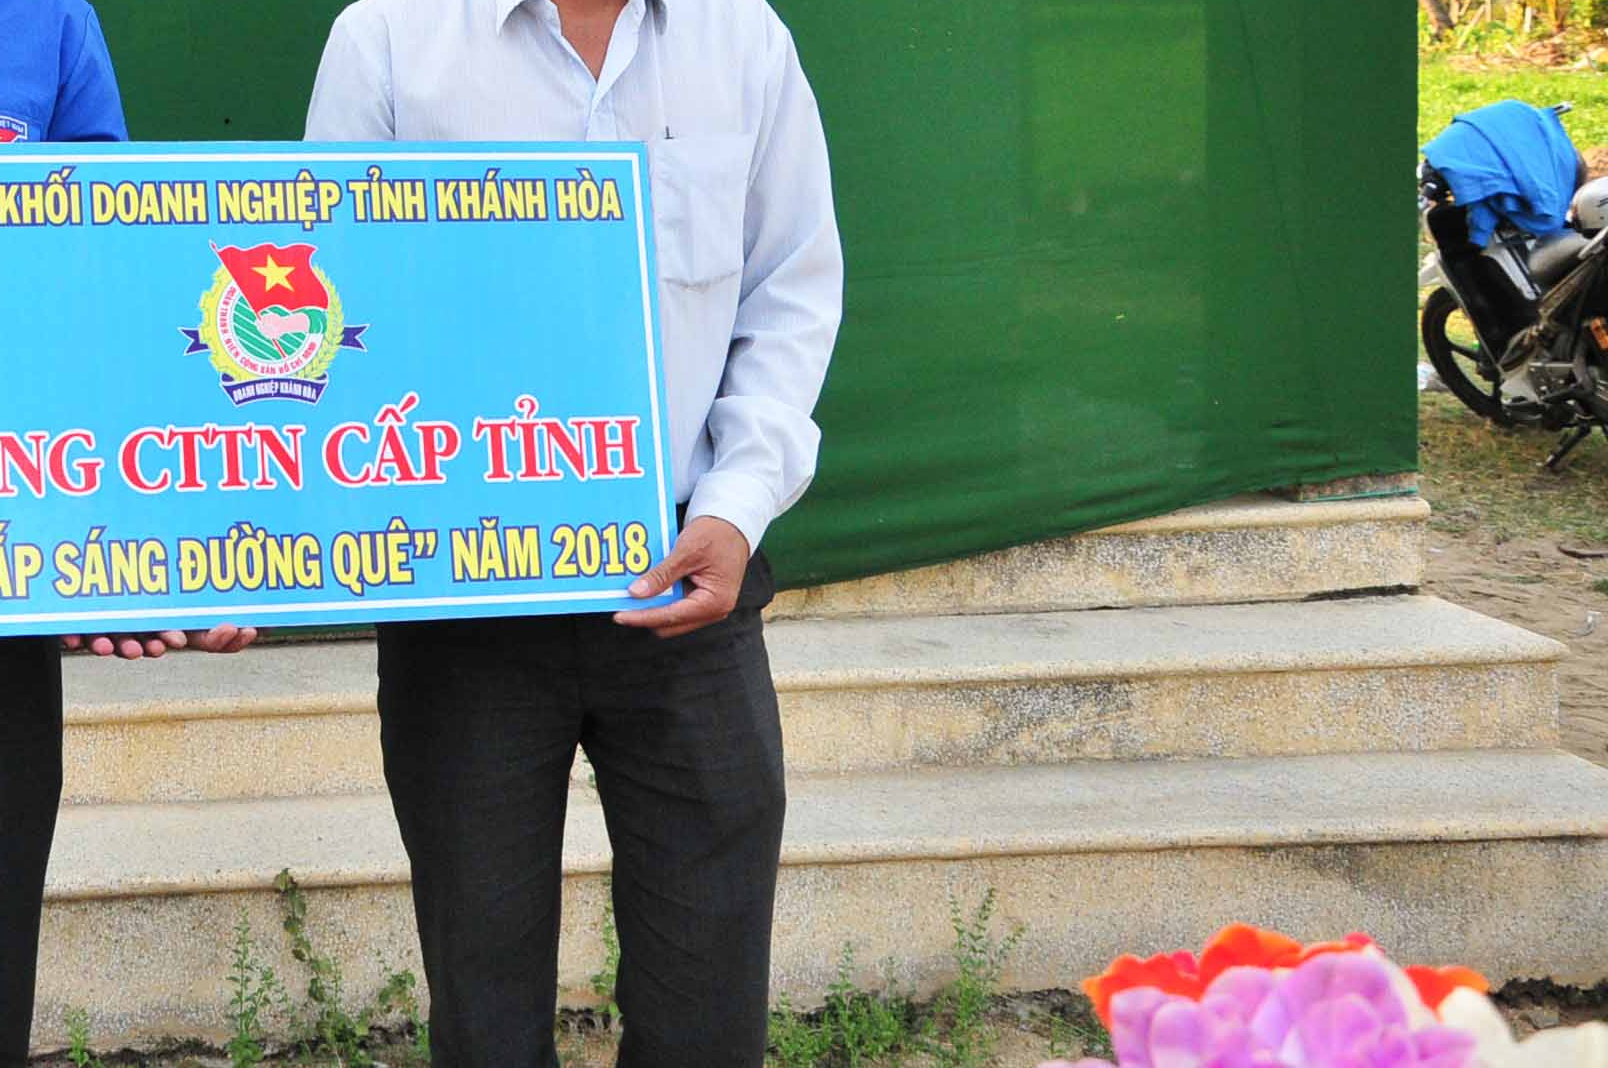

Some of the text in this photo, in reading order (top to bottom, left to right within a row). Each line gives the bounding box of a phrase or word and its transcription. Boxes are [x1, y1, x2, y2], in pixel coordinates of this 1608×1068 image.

[92, 181, 208, 226] DOANH
[217, 171, 342, 231] NGHIỆP
[348, 166, 426, 224] TỈNH
[435, 169, 548, 223] KHÁNH
[555, 168, 624, 222] HÒA
[119, 421, 305, 495] CTTN
[324, 393, 461, 488] CẤP
[473, 394, 644, 483] TỈNH
[53, 525, 169, 600] SÁNG
[178, 522, 321, 594] ĐƯỜNG
[334, 516, 437, 592] QUÊ”
[451, 518, 543, 584] NĂM
[552, 522, 651, 577] 2018
